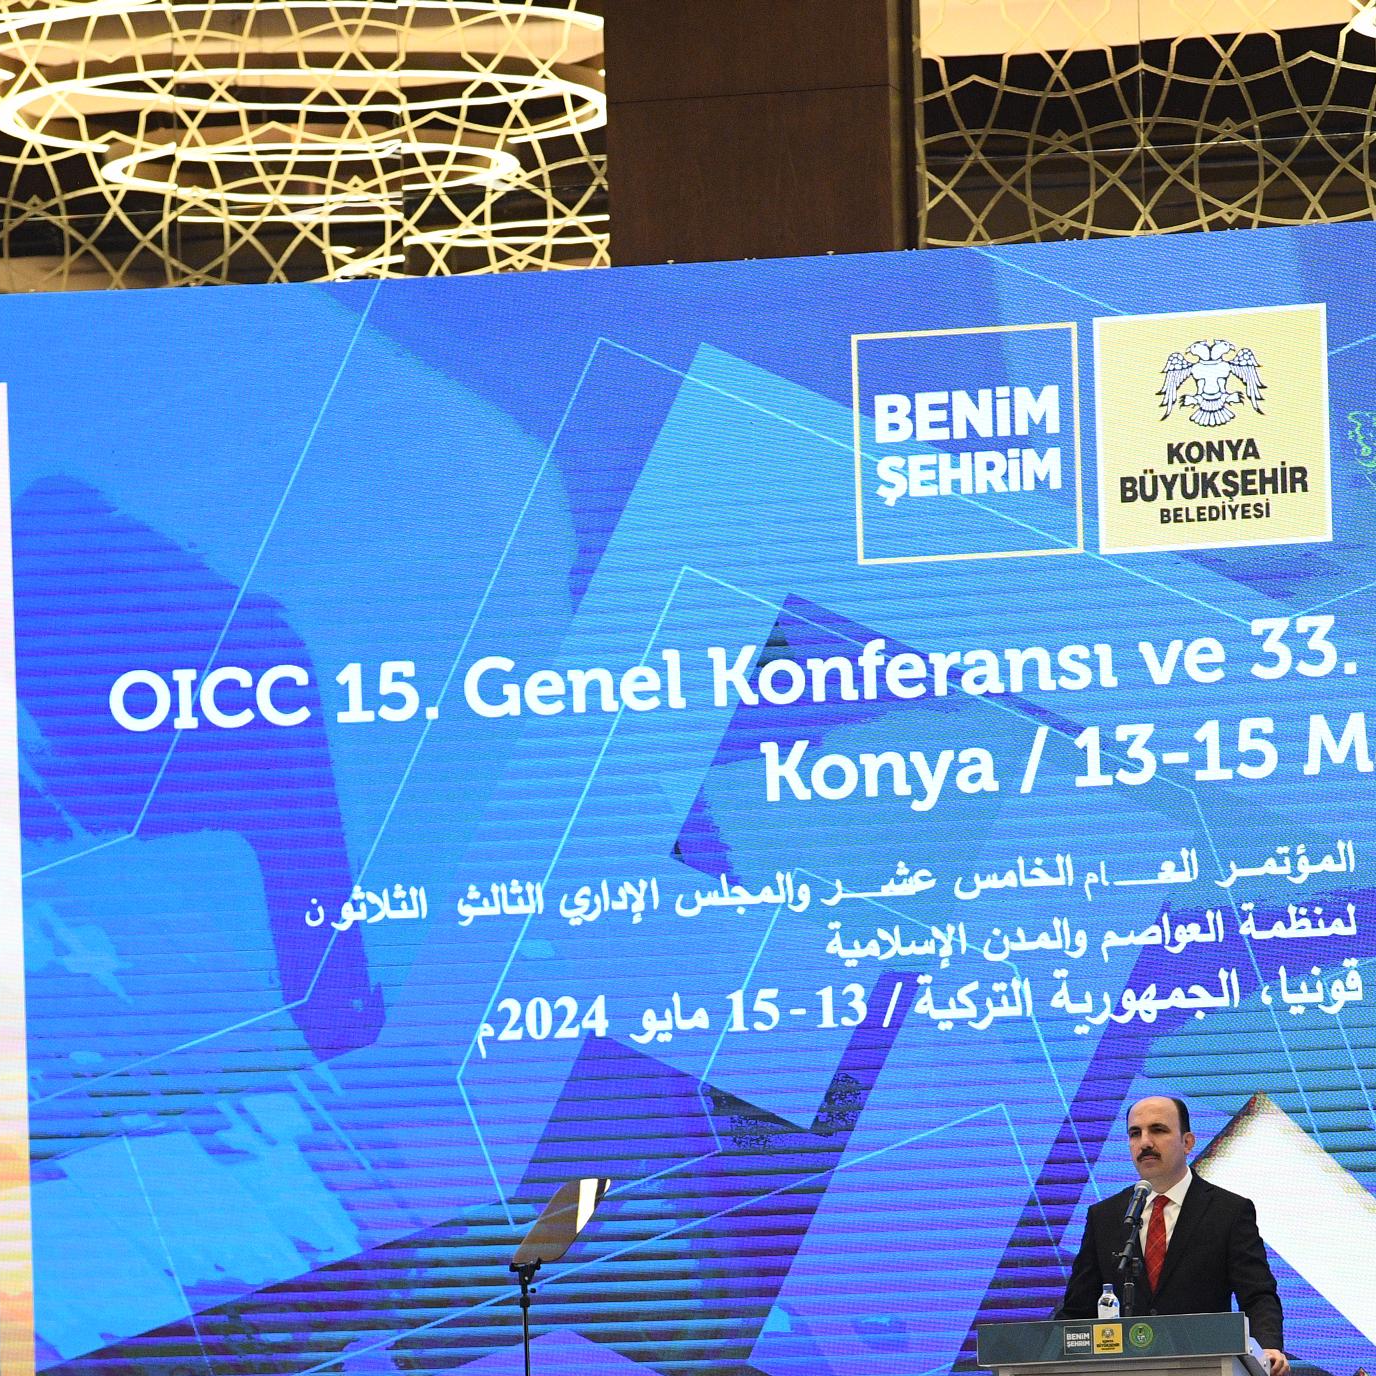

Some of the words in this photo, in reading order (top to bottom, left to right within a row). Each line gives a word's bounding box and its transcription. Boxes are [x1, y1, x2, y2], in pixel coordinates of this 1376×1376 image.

[1167, 438, 1260, 464] KONYA
[1119, 461, 1309, 504] BÜYÜKŞEHİR
[1159, 499, 1271, 526] BELEDİYESİ
[109, 664, 311, 731] OICC
[335, 660, 439, 723] 15.
[463, 648, 687, 718] Genel
[707, 638, 1118, 707] Konferansı
[1138, 637, 1225, 684] ve
[1249, 615, 1357, 680] 33.
[759, 740, 1000, 812] Konya
[1019, 726, 1050, 794] /
[1074, 716, 1279, 788] 13-15
[954, 854, 1075, 900] الخامس
[1215, 839, 1356, 888] المؤتمر
[559, 877, 659, 926] الإداري
[675, 871, 811, 917] والمجلس
[825, 920, 967, 969] الإسلامية
[982, 916, 1088, 962] والمدن
[1100, 909, 1225, 962] العواصم
[1238, 902, 1357, 939] لمنظمة
[629, 991, 709, 1044] مايو
[882, 981, 903, 1028] /
[914, 975, 1032, 1031] التركية
[1050, 968, 1241, 1035] الجمهورية
